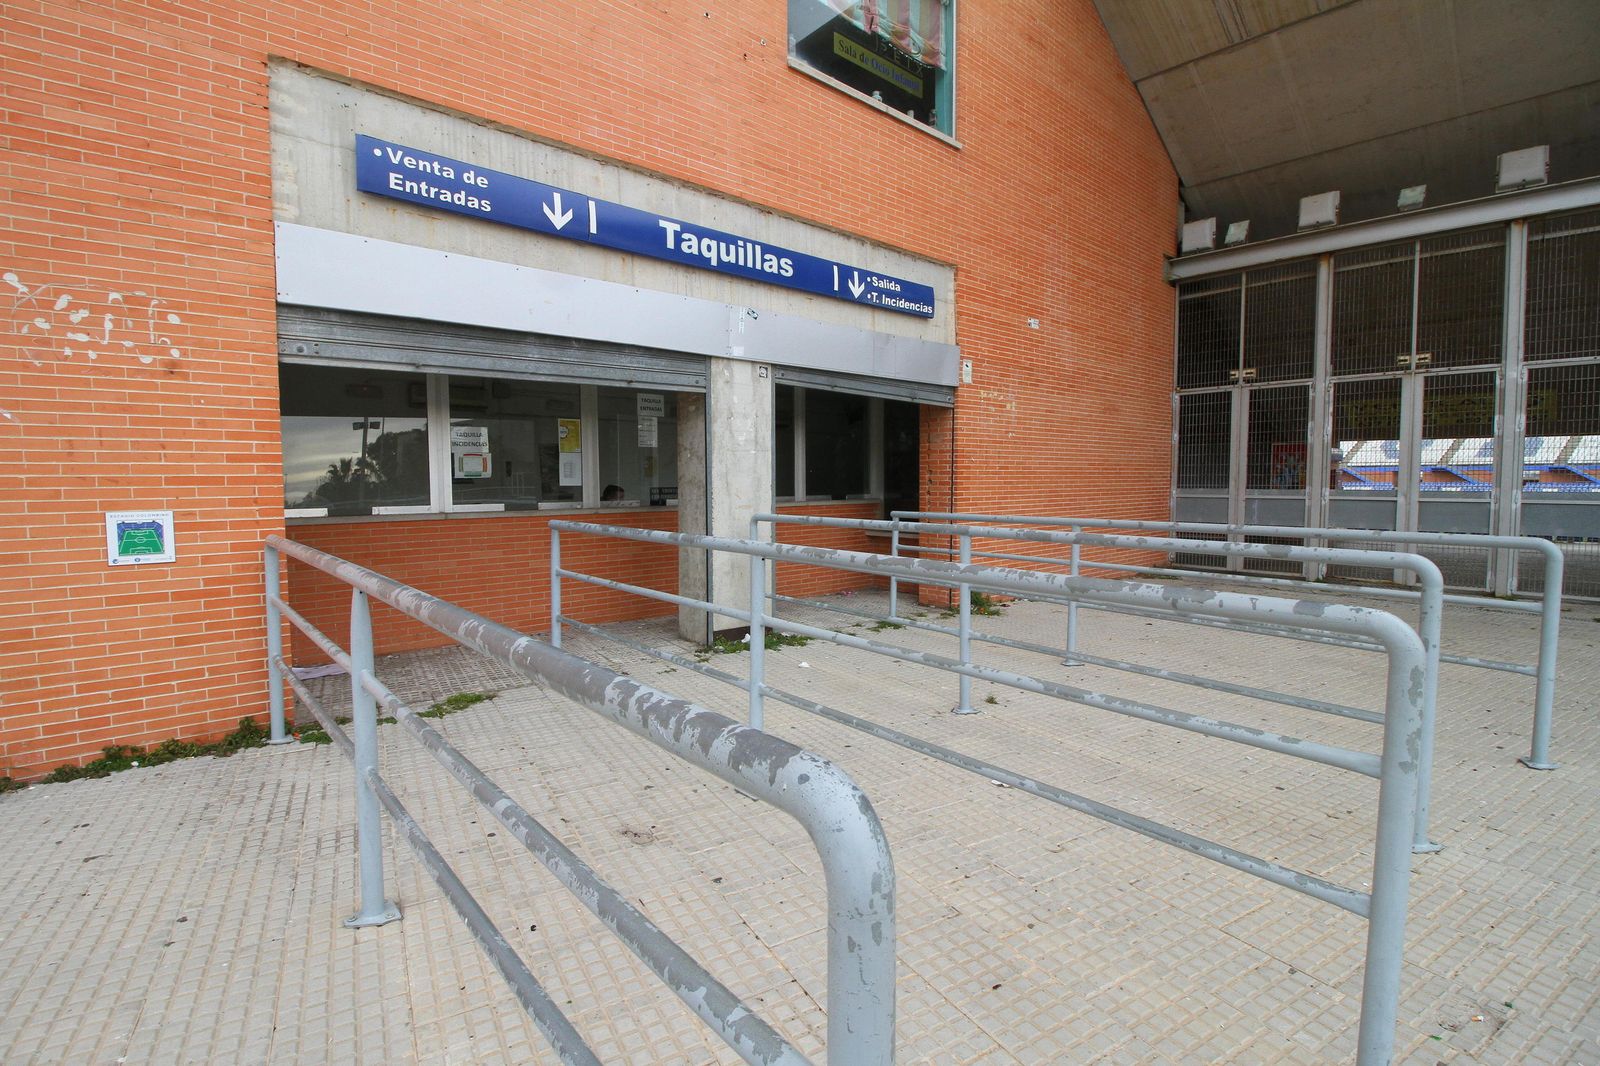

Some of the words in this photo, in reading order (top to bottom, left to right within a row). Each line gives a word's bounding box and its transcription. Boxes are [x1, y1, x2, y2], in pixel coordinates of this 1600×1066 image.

[386, 147, 455, 180] Venta
[462, 170, 489, 188] de
[389, 172, 492, 212] Entradas
[658, 219, 794, 278] Taquillas
[872, 276, 900, 291] Salida
[882, 294, 933, 314] Incidencias
